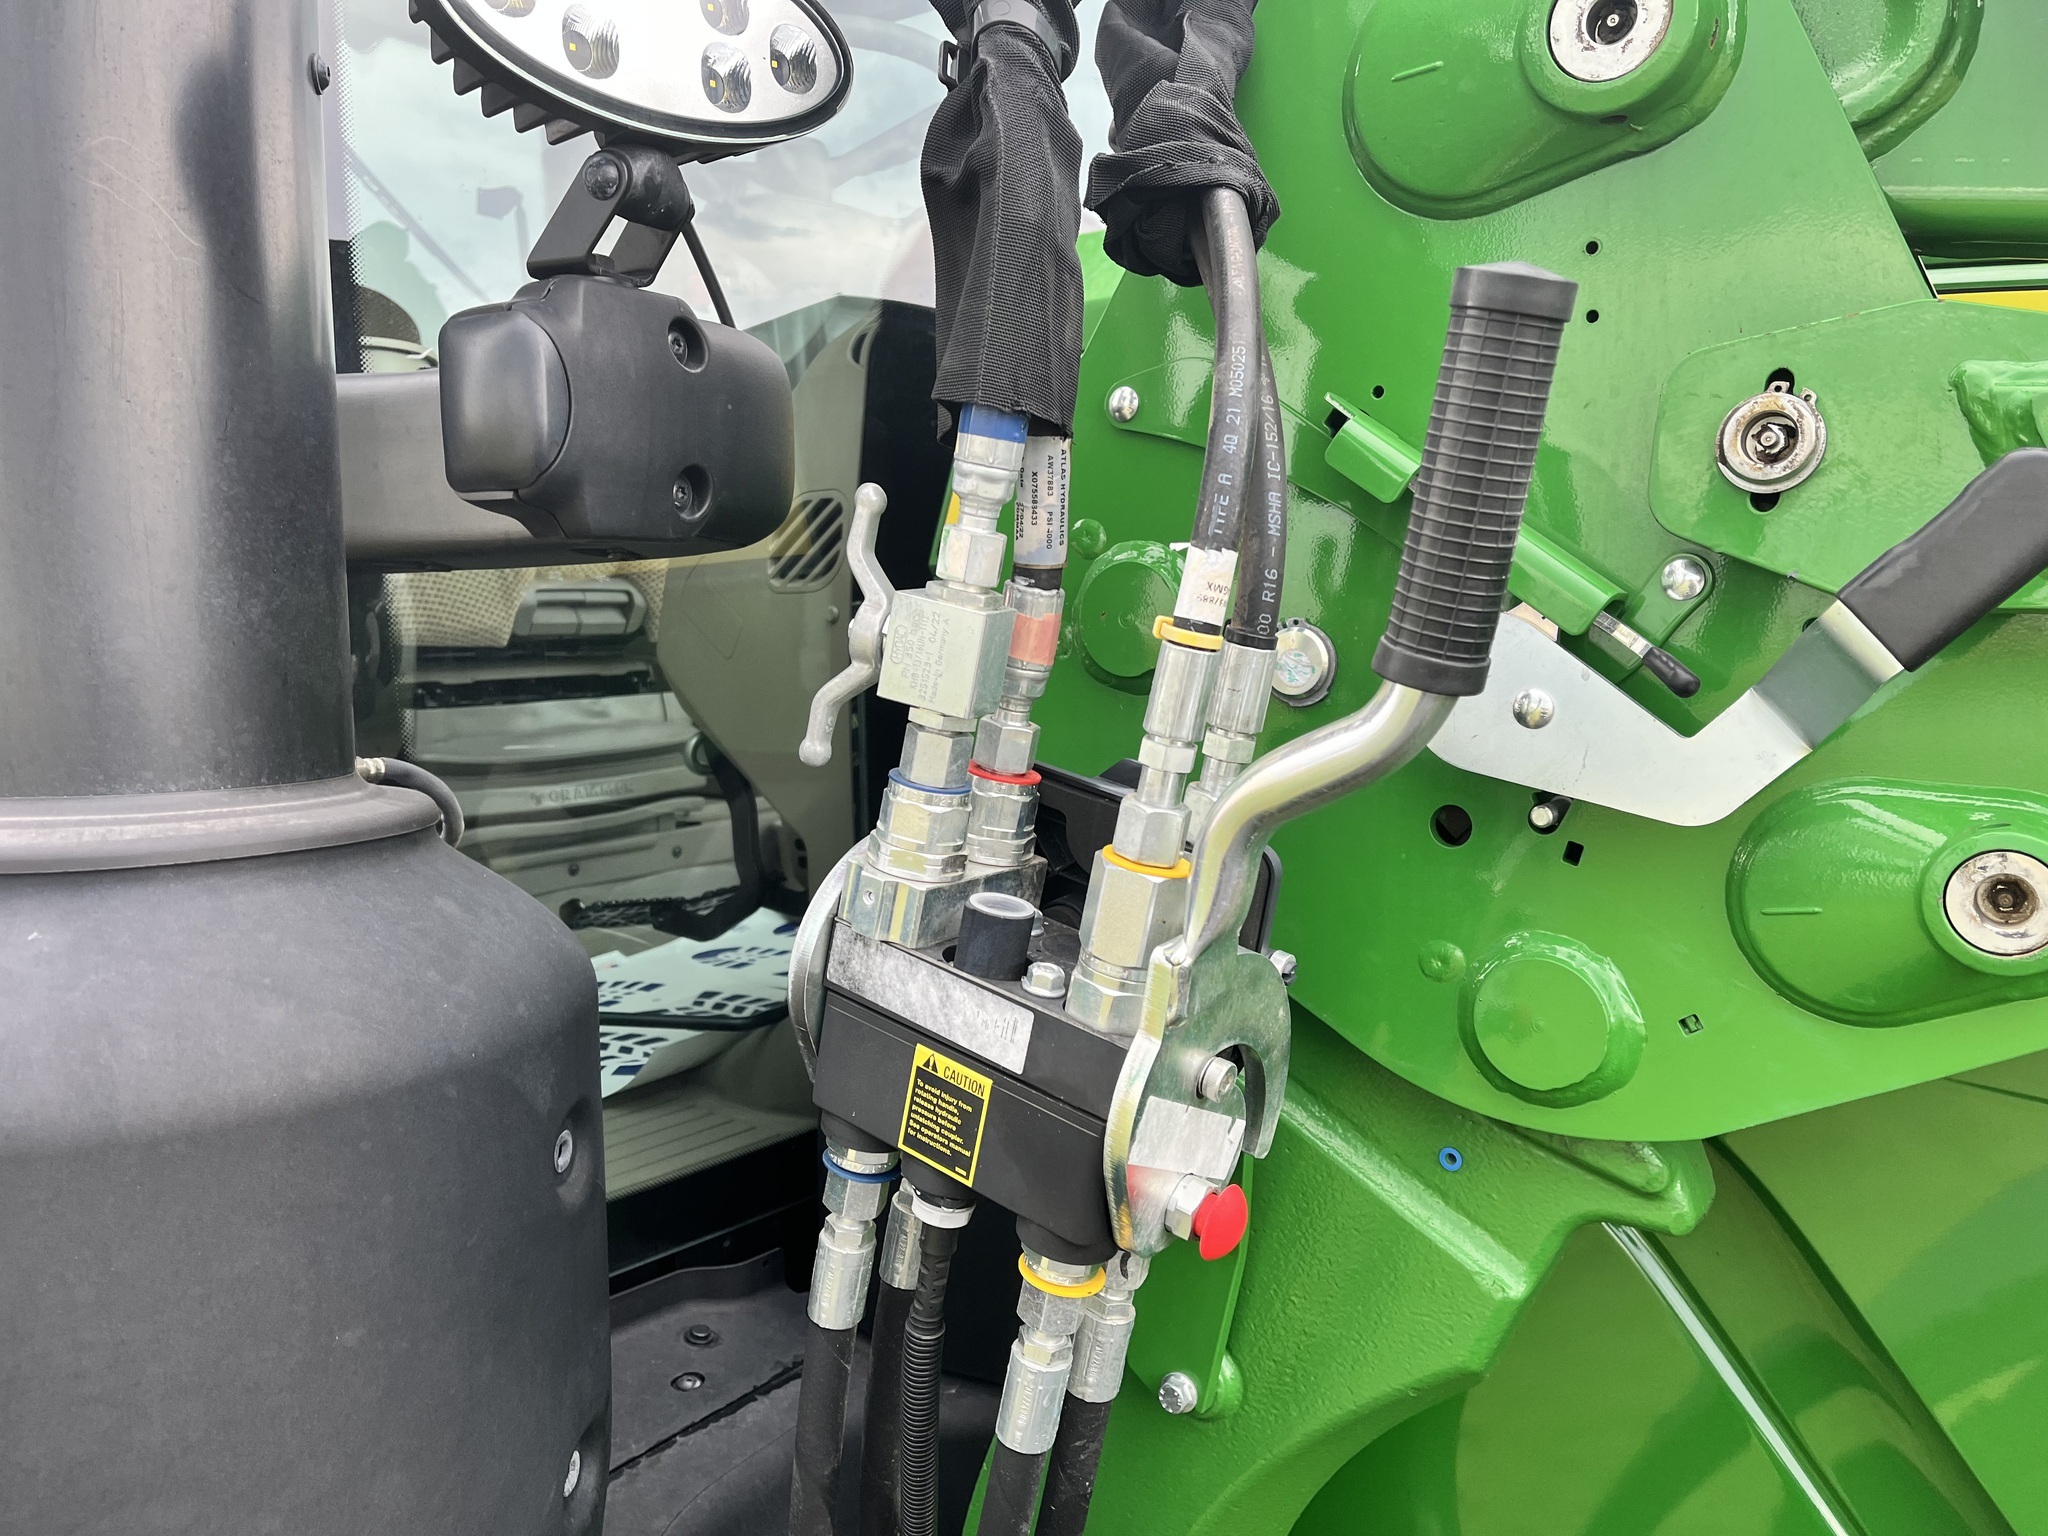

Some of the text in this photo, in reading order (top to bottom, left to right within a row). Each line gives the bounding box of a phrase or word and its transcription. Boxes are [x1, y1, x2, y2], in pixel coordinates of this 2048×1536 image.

[1218, 473, 1232, 485] A
[1226, 408, 1241, 425] 21
[1268, 491, 1282, 536] MSHA
[1262, 568, 1278, 603] R16
[915, 1088, 938, 1105] rotating
[917, 1078, 973, 1113] To avoid injury from
[943, 1066, 985, 1097] CAUTION
[910, 1112, 940, 1133] unlatching
[912, 1104, 957, 1131] pressure before
[913, 1096, 962, 1125] release hydraulic
[907, 1127, 952, 1156] for instructions.
[909, 1119, 972, 1157] See operators manual
